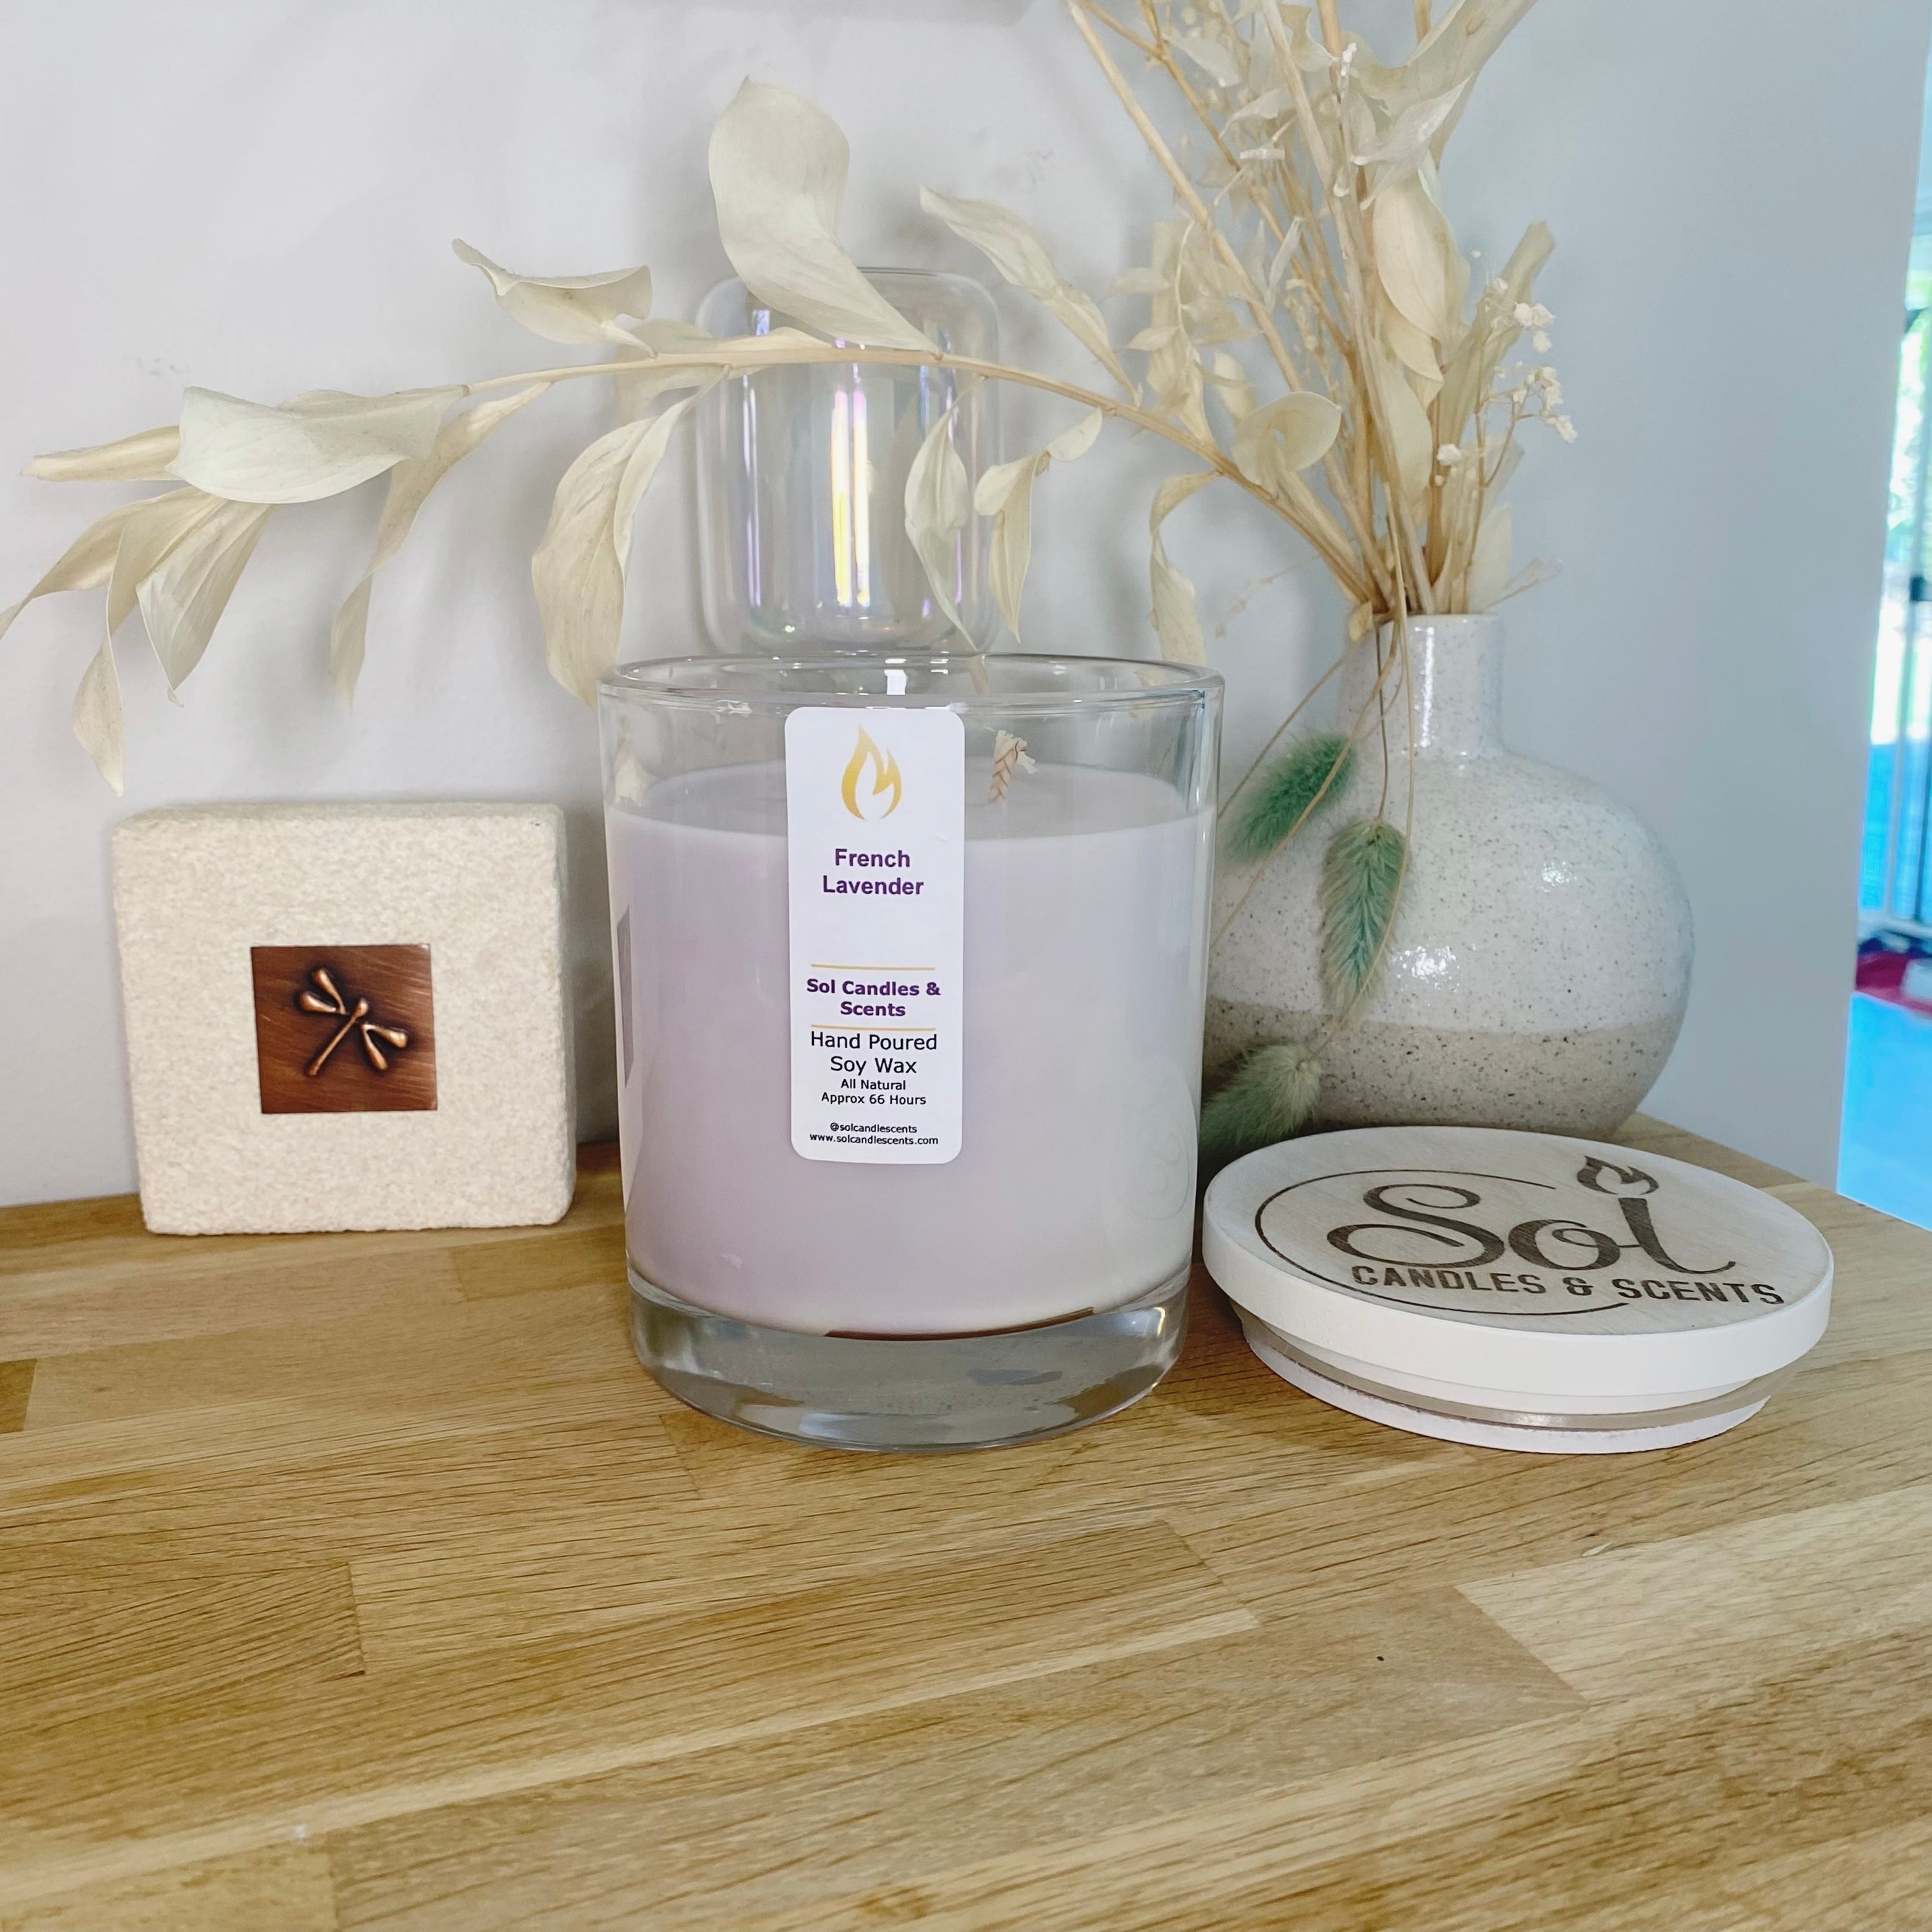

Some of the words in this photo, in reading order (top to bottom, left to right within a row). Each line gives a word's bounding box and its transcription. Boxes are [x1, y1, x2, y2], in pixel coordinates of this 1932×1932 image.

[835, 848, 910, 867] French
[823, 875, 924, 895] Lavender
[806, 978, 835, 994] Sol
[842, 981, 920, 996] Candles
[926, 982, 941, 996] &
[840, 1001, 906, 1016] Scents
[811, 1031, 860, 1048] Hand
[869, 1034, 937, 1050] Poured
[830, 1056, 867, 1076] Soy
[875, 1058, 917, 1074] Wax
[840, 1079, 856, 1089] All
[861, 1079, 906, 1090] Natural
[821, 1092, 865, 1105] Approx
[869, 1094, 885, 1104] 66
[890, 1095, 926, 1105] Hours
[830, 1122, 917, 1133] @solcandlescents
[810, 1133, 938, 1145] www.solcandlescents.com
[1327, 1184, 1736, 1274] Sol
[1351, 1265, 1546, 1294] CANDLES
[1562, 1277, 1594, 1296] &
[1612, 1278, 1785, 1305] SCENTS
